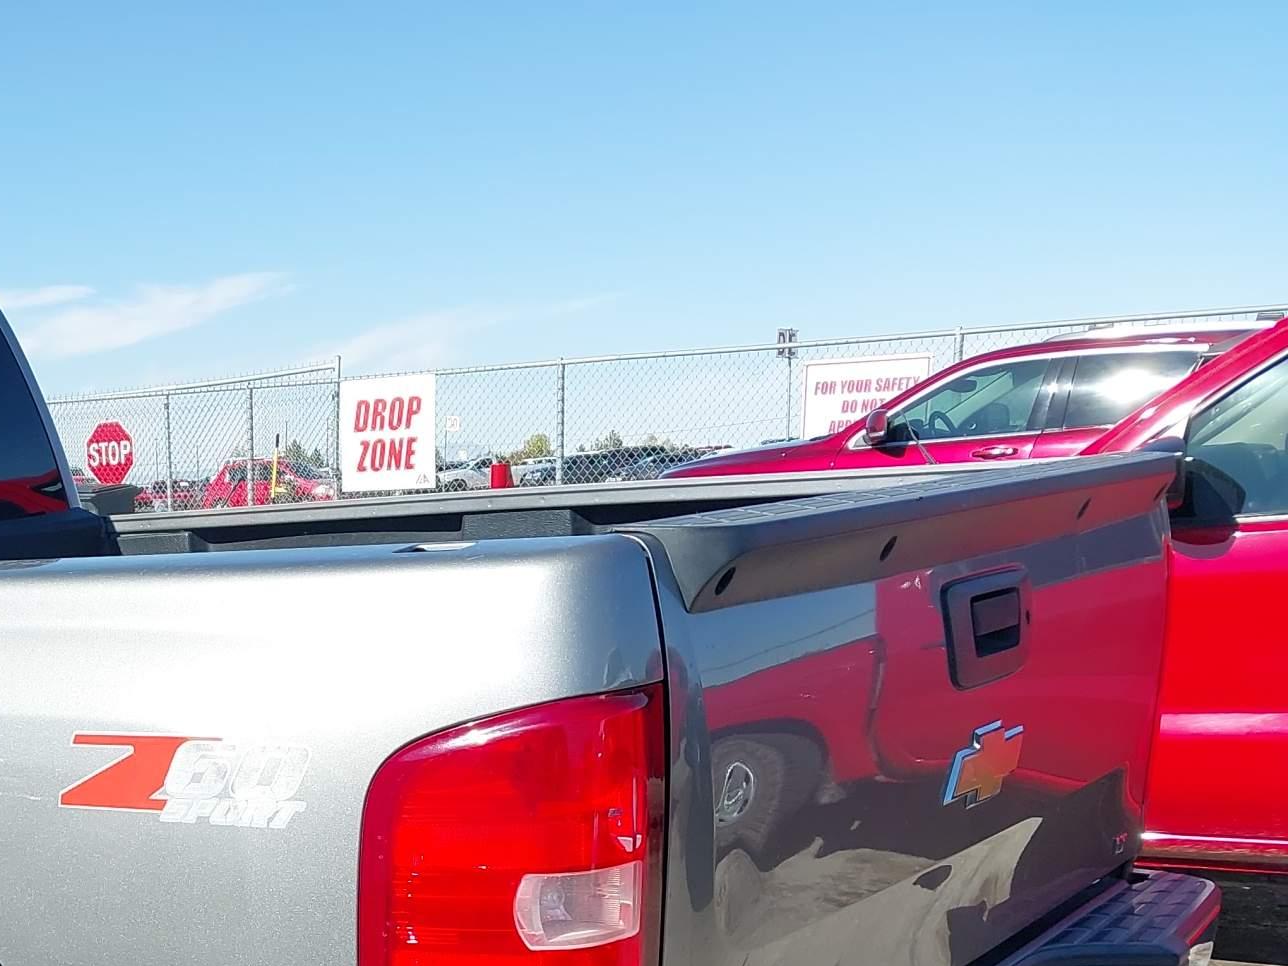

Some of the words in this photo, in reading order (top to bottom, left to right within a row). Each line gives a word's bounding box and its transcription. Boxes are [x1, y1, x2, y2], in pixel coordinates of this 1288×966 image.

[814, 380, 837, 396] FOR
[841, 379, 872, 394] YOUR
[354, 396, 422, 433] DROP
[841, 399, 858, 414] DO
[89, 440, 131, 467] STOP
[356, 437, 419, 472] ZONE
[159, 797, 307, 829] SPORT
